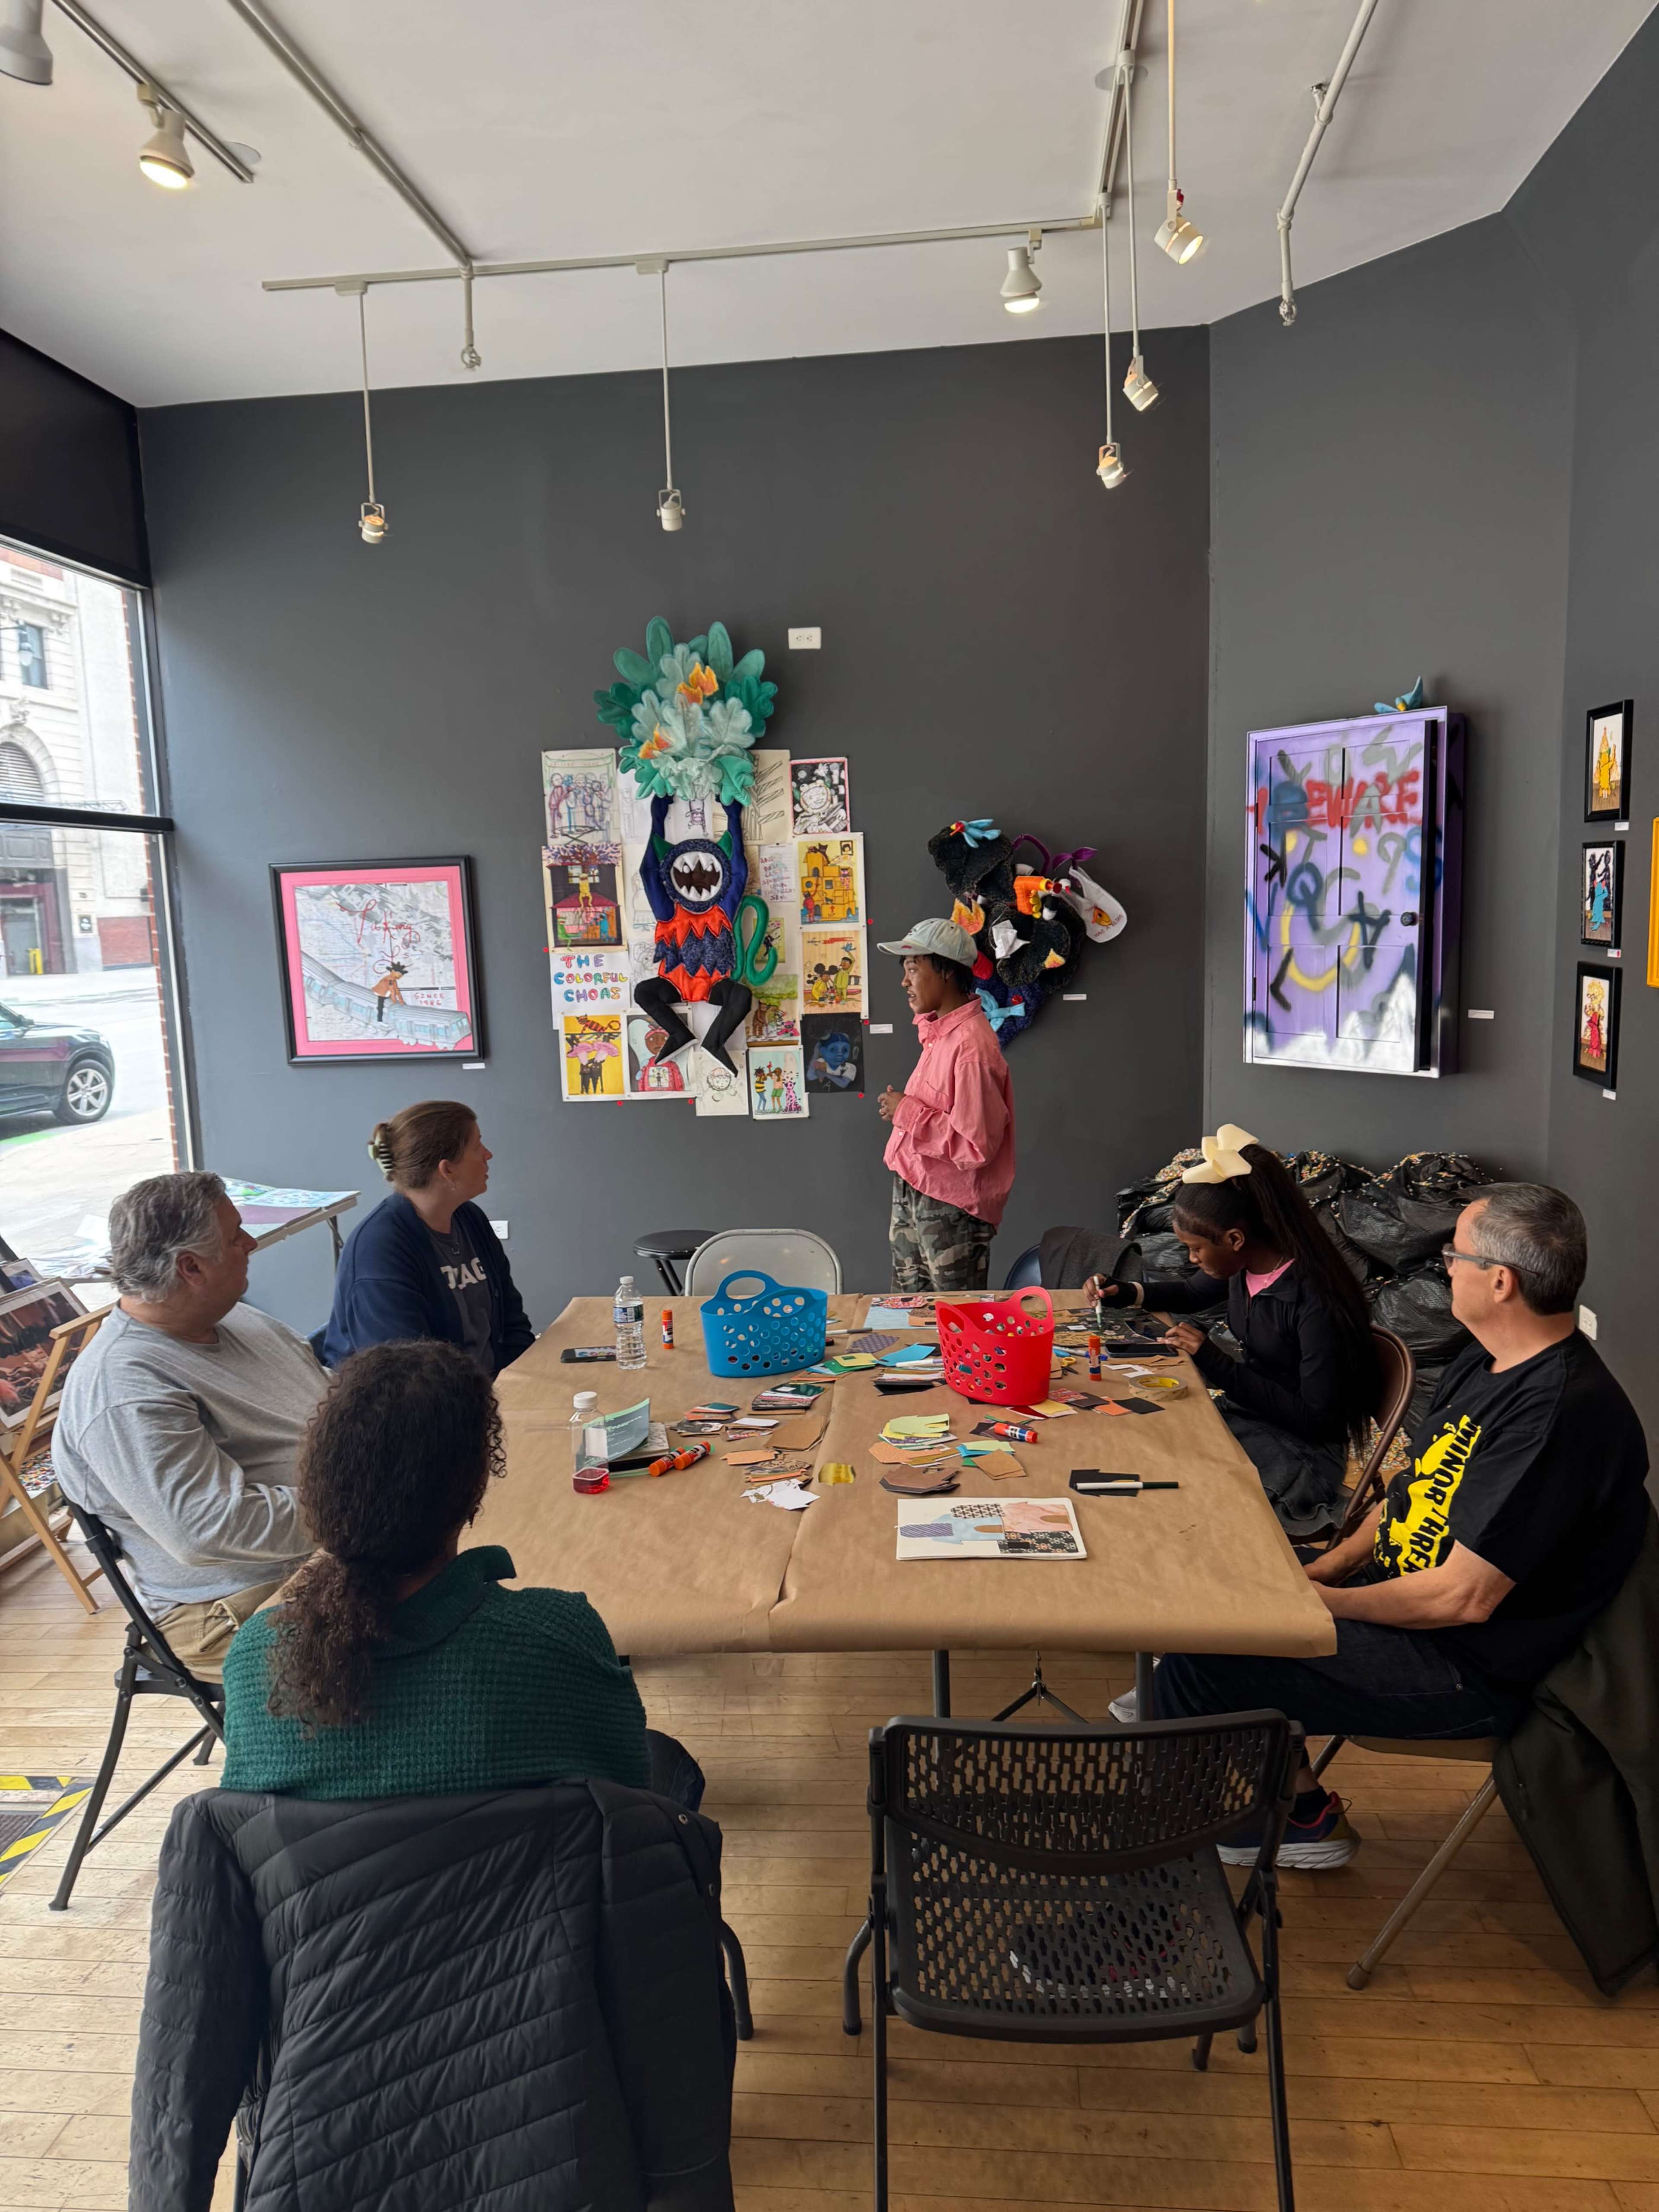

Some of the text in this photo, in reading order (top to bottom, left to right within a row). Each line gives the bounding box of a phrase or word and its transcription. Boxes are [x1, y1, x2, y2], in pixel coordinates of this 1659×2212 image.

[560, 954, 604, 968] THE
[554, 972, 628, 985] COLORFUL
[563, 987, 621, 1003] CHOAS
[1424, 1421, 1478, 1506] MINOR
